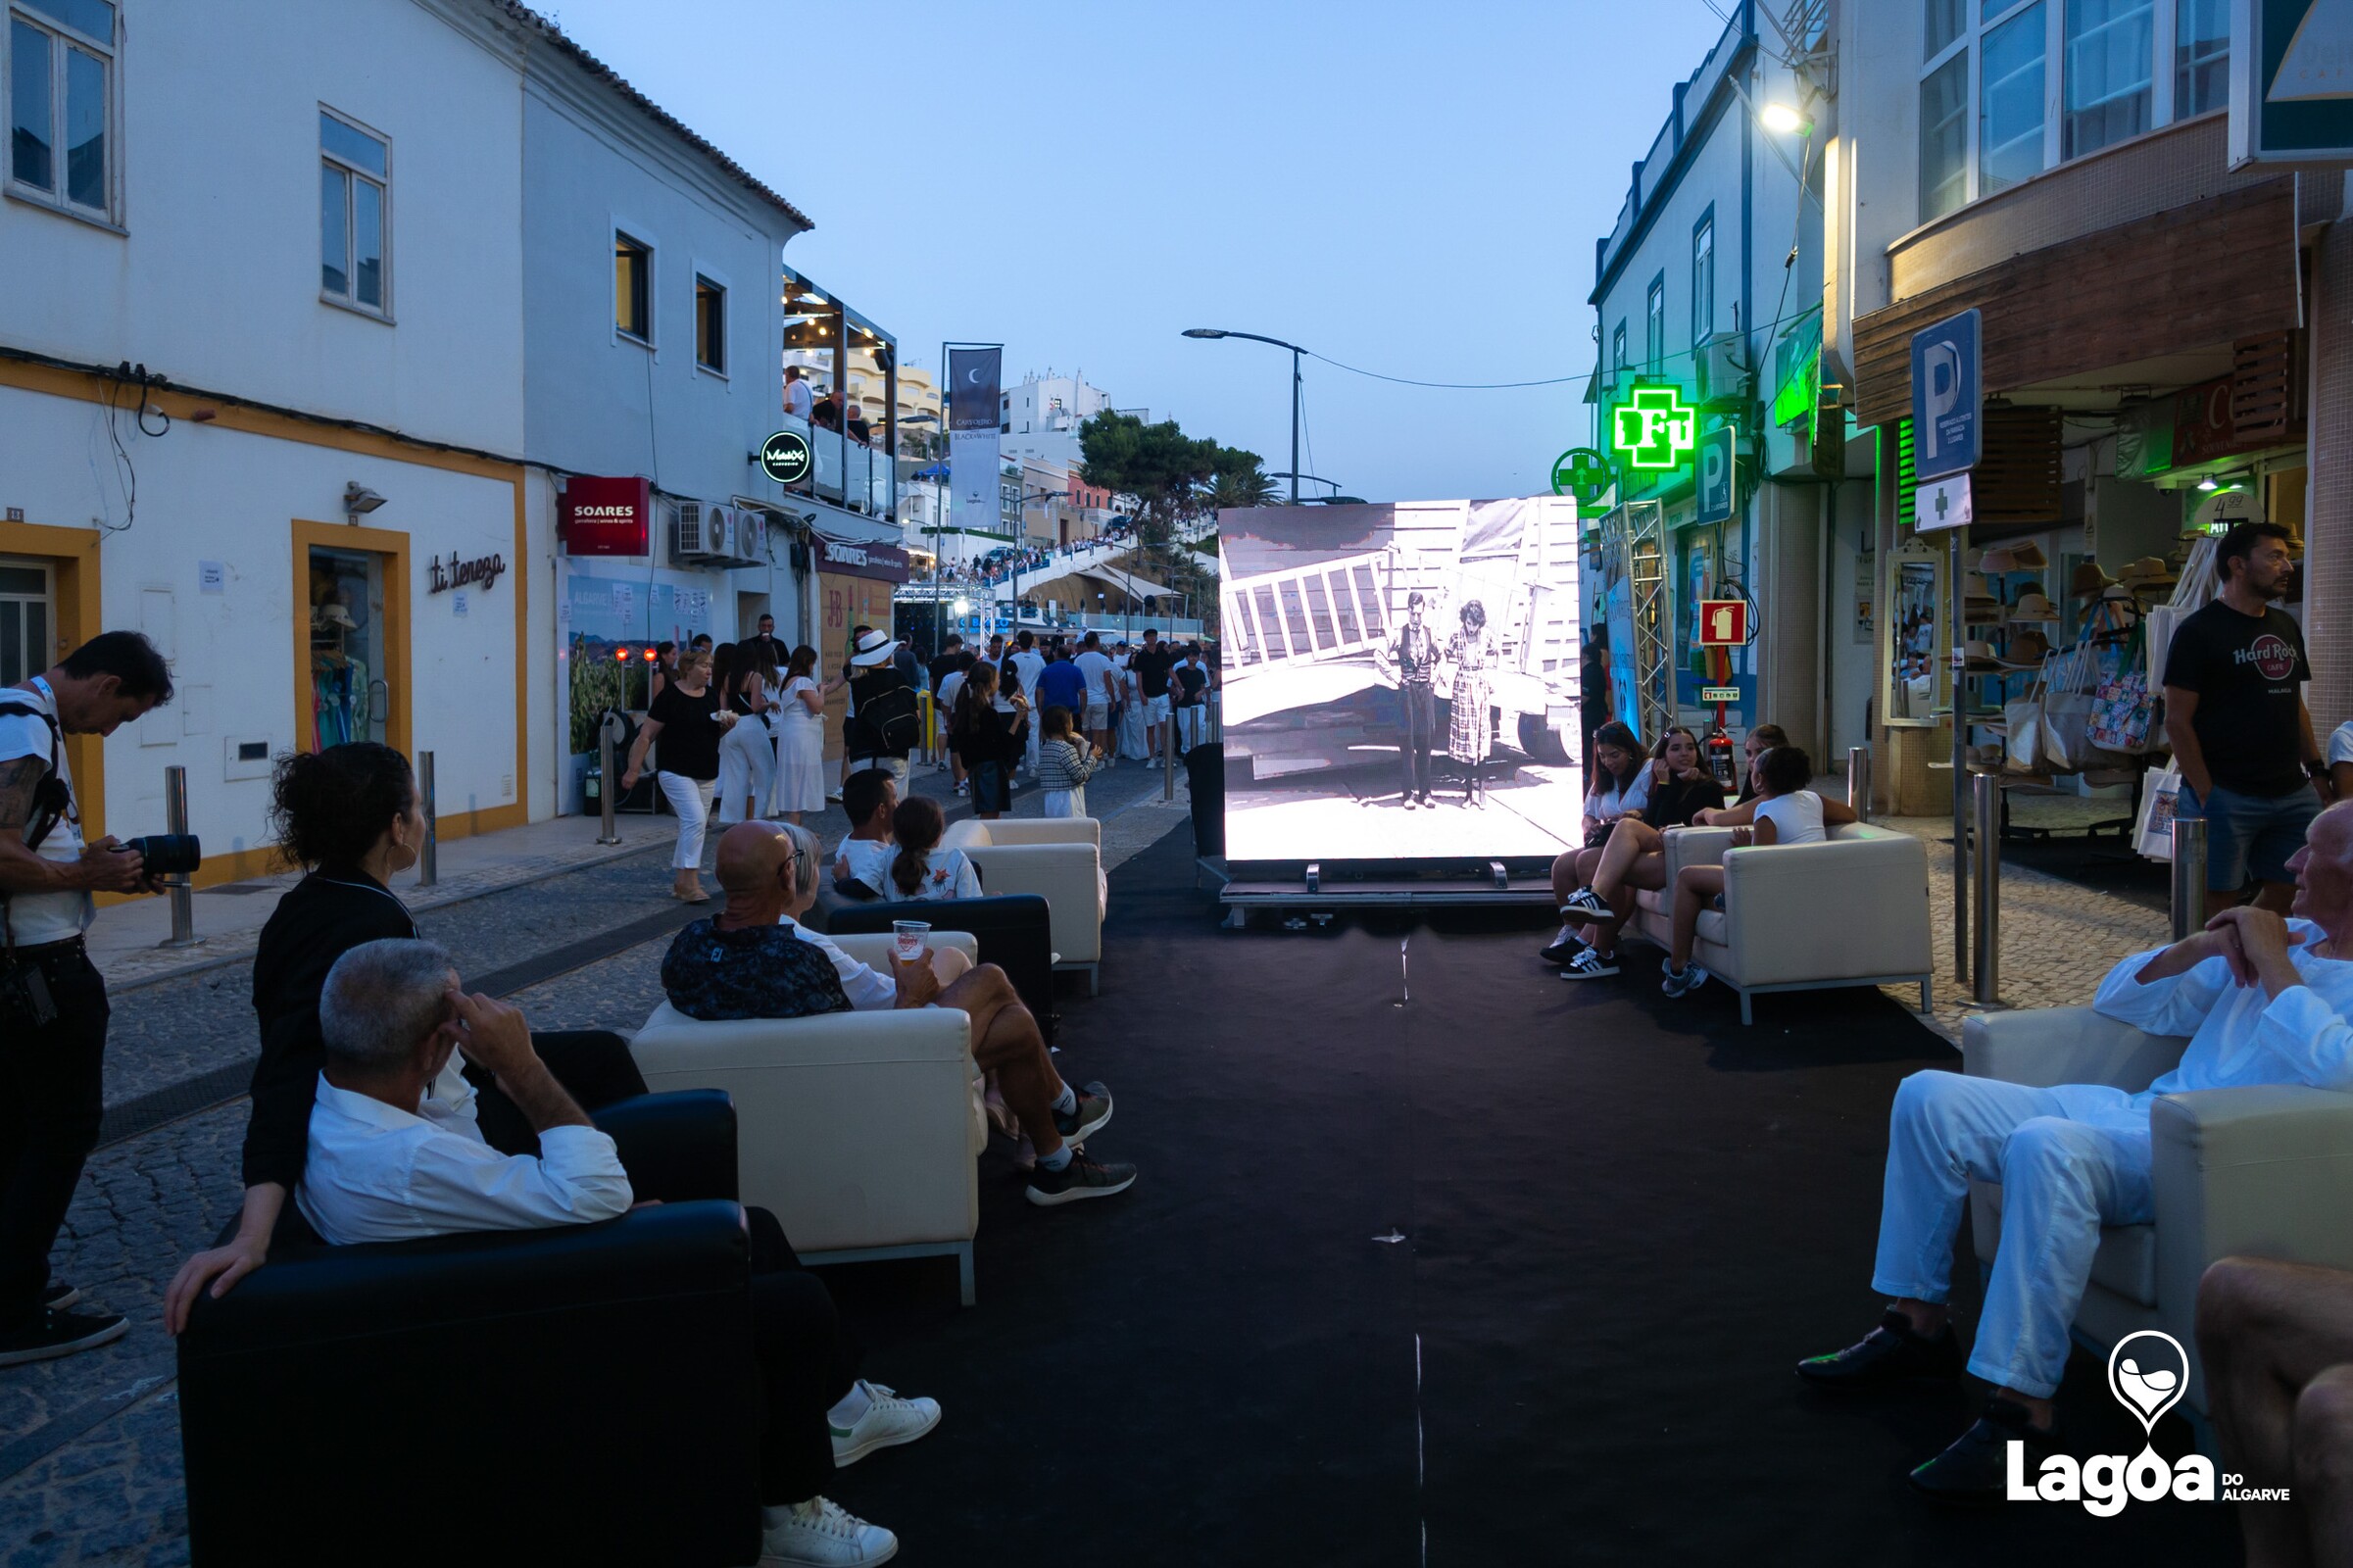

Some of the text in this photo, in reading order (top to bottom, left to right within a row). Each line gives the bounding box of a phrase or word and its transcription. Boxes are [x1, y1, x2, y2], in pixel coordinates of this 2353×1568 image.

[1924, 340, 1962, 460] P
[1702, 443, 1724, 513] P
[574, 506, 634, 516] SOARES
[824, 543, 867, 566] SOARES
[430, 551, 506, 594] ti tereza
[2232, 643, 2300, 665] Hard Rock
